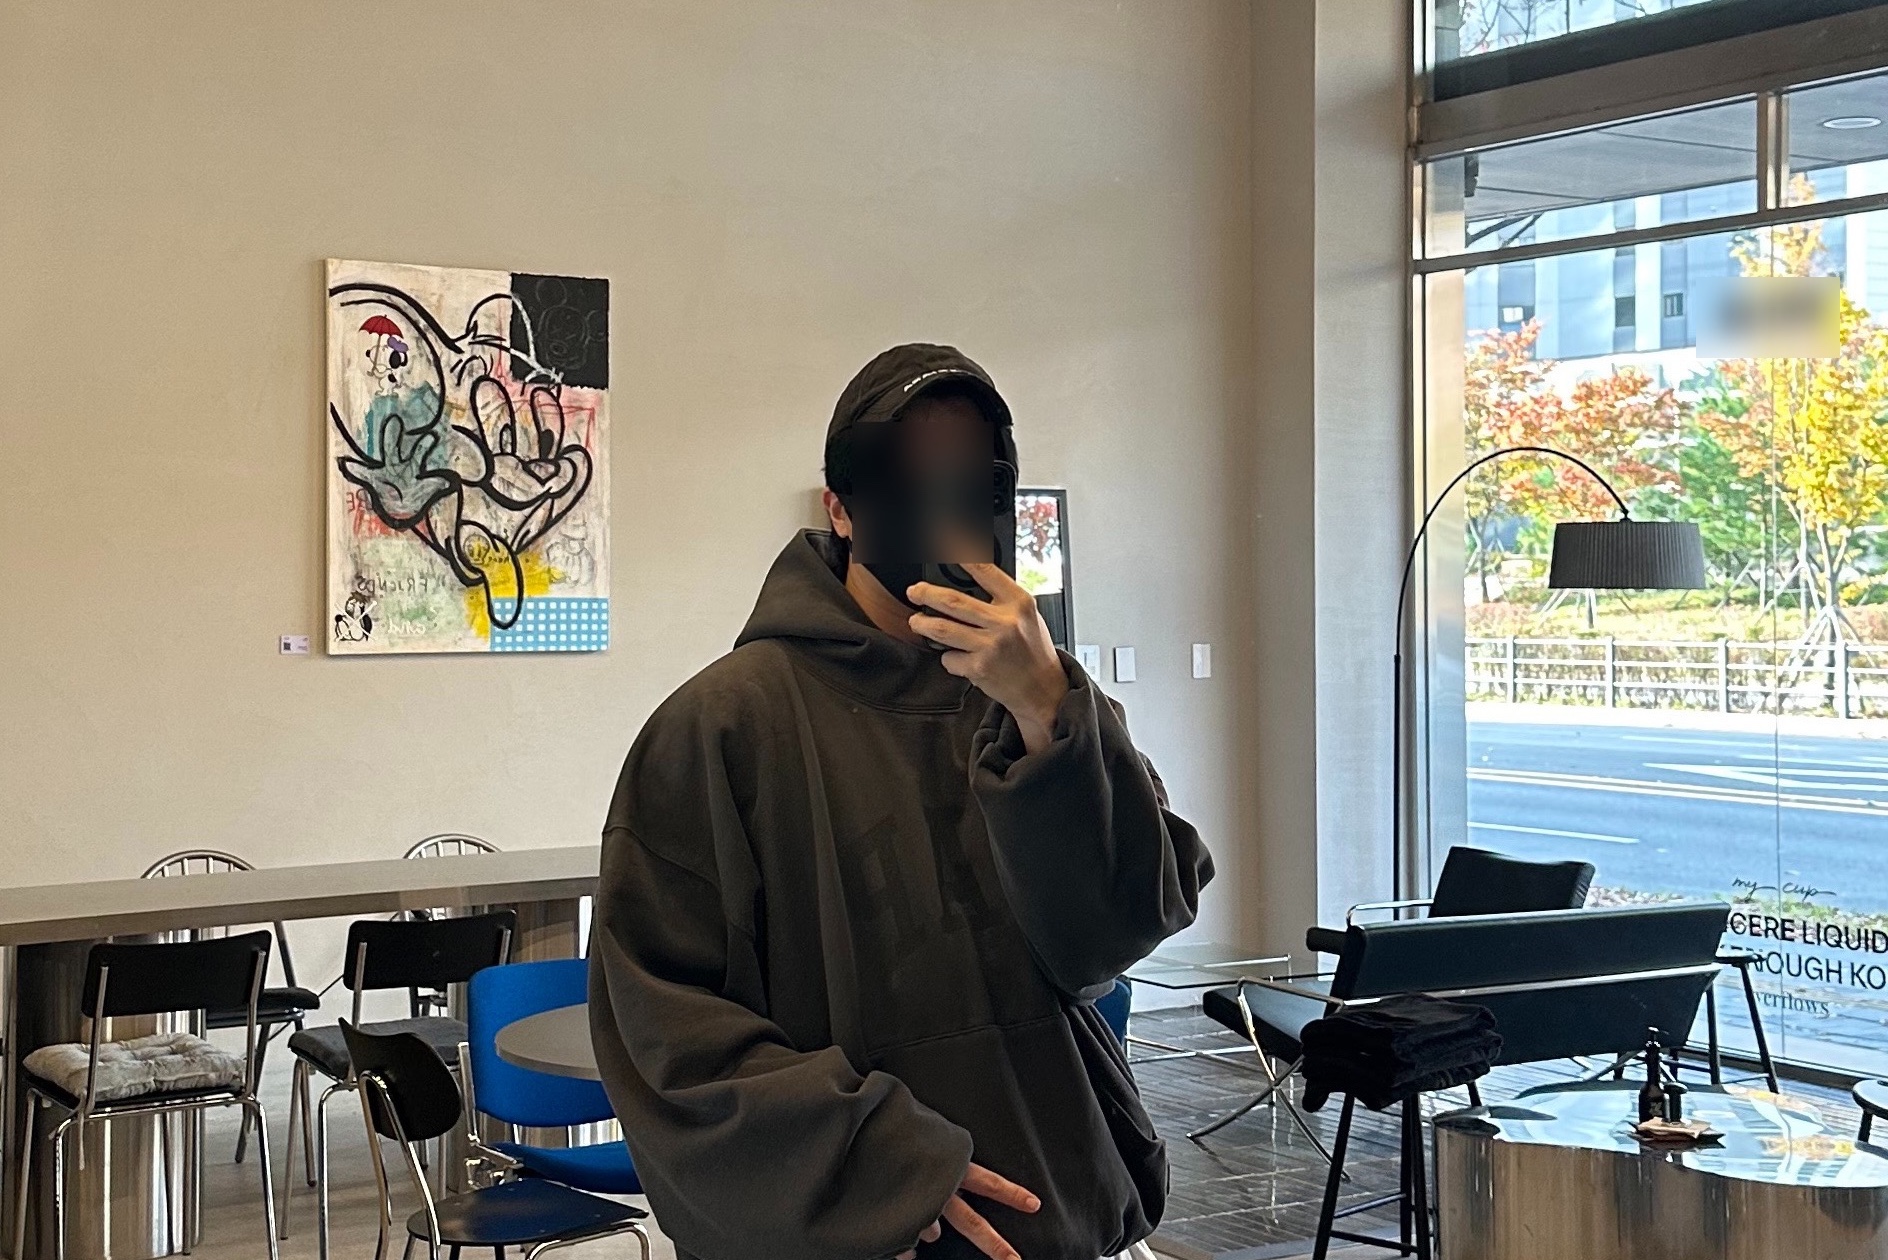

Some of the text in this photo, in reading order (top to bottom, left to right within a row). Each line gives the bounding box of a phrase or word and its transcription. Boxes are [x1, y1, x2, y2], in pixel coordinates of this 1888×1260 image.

[1732, 877, 1837, 902] my cup
[1802, 920, 1888, 954] LIQUID
[1755, 991, 1829, 1017] verflows
